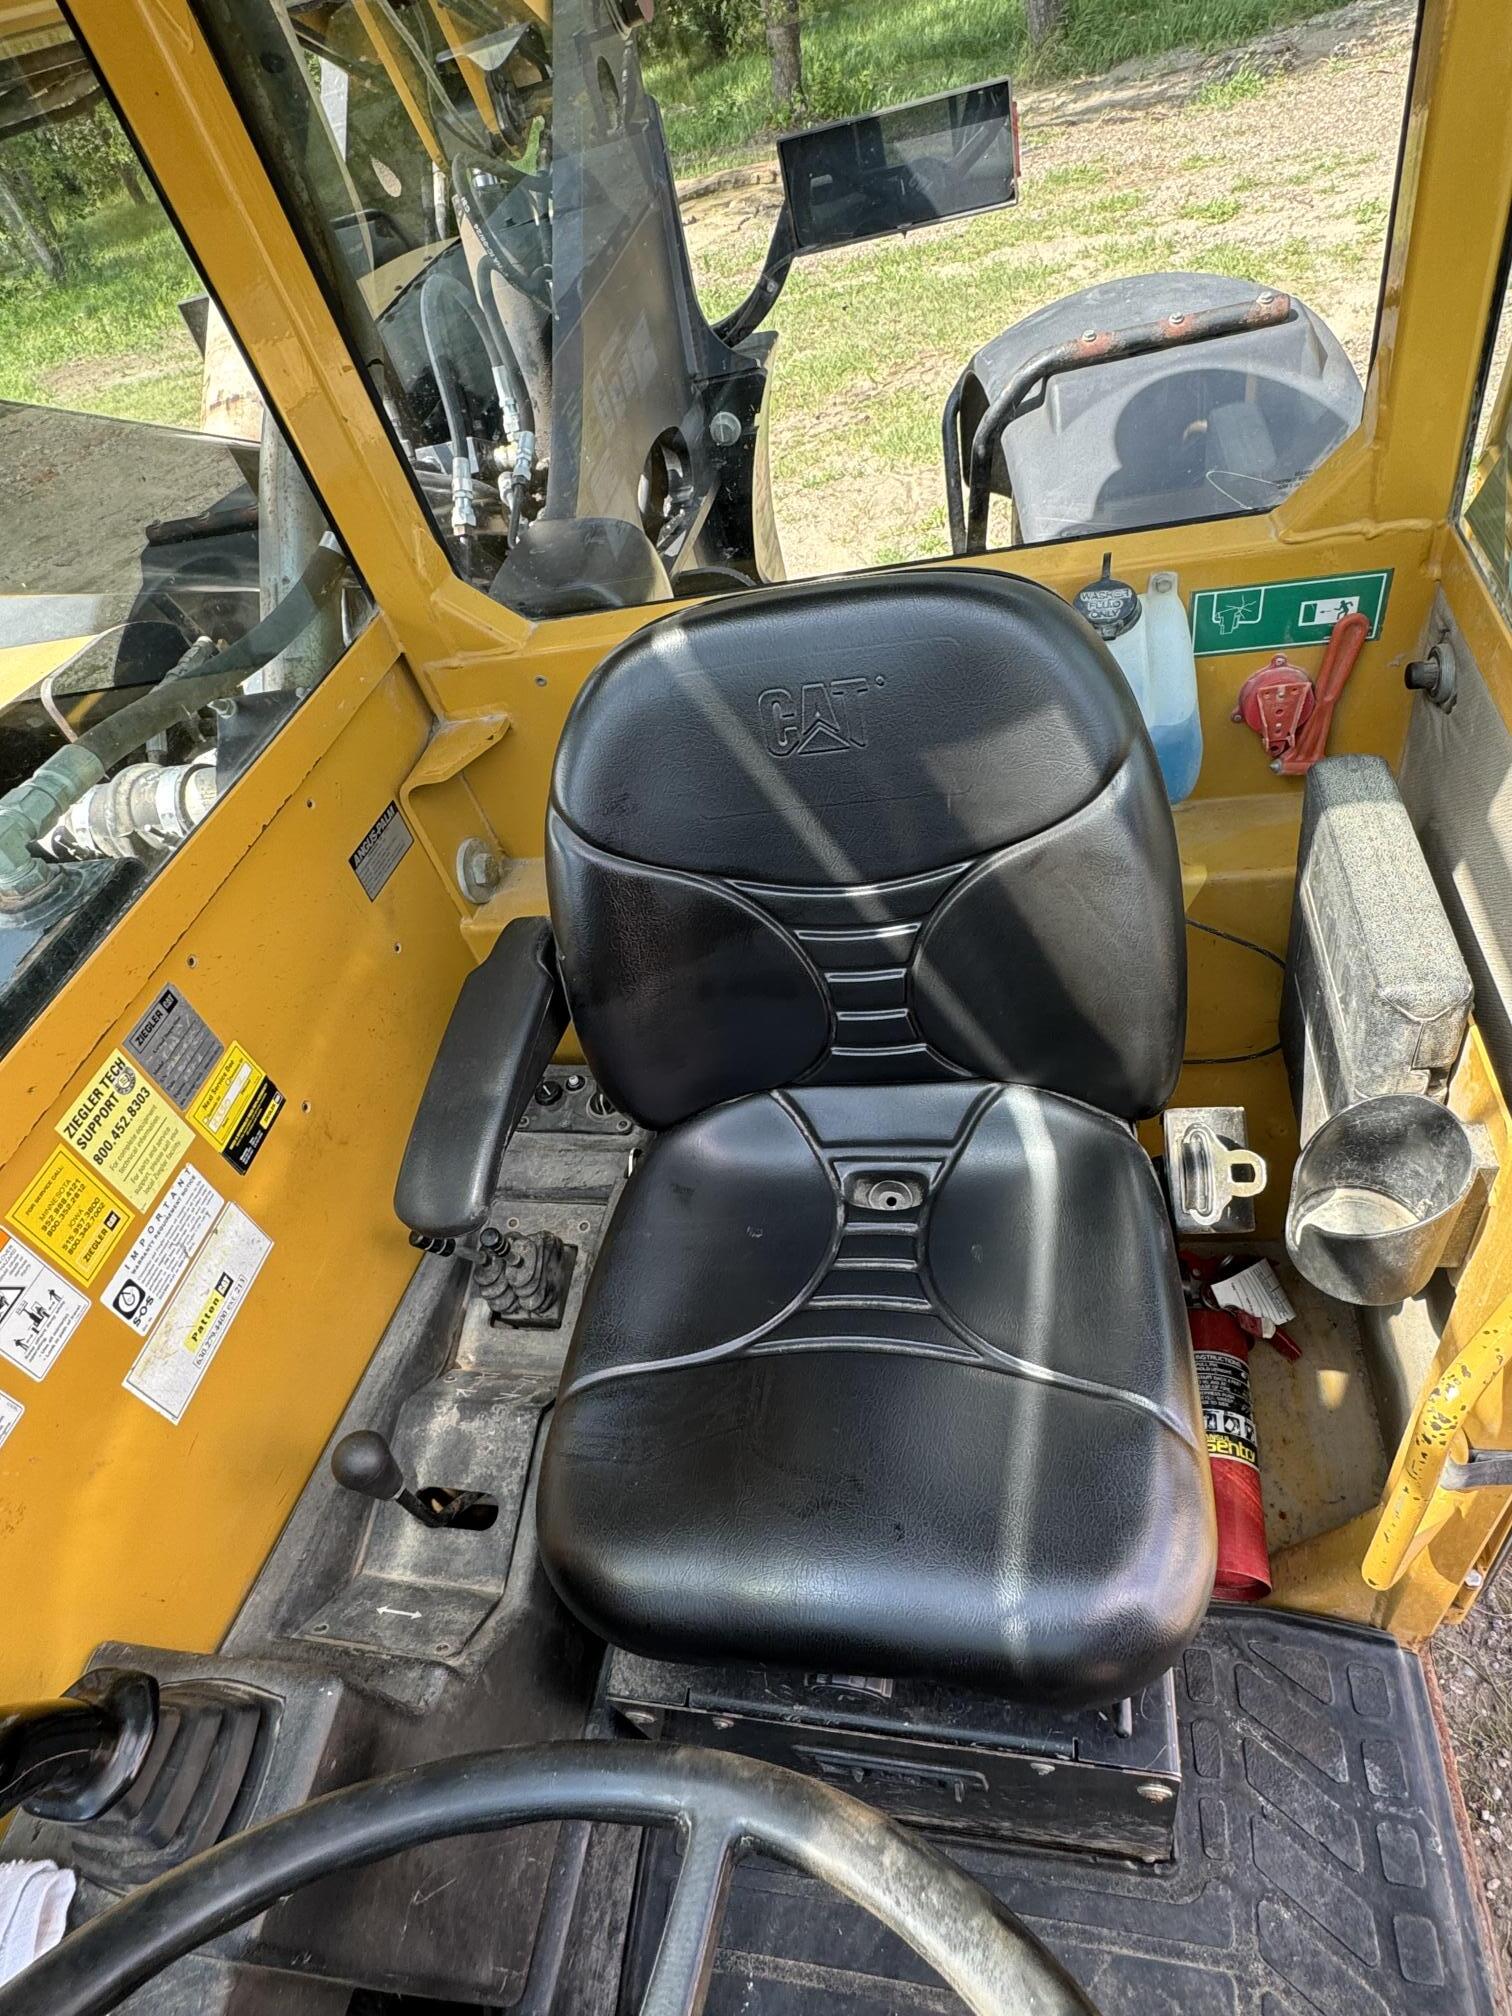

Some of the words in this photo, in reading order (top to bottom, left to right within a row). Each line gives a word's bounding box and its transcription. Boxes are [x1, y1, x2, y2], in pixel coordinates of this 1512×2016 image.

[1089, 609, 1120, 619] ONLY
[758, 678, 868, 758] CAT
[134, 1008, 163, 1046] ZIEGLER
[62, 1086, 105, 1139] ZIEGLER
[98, 1056, 126, 1091] TECH
[201, 1093, 214, 1110] Next
[211, 1071, 227, 1094] Service
[74, 1091, 121, 1151] SUPPORT
[91, 1085, 152, 1166] 800.452.8303
[109, 1159, 119, 1171] For
[116, 1133, 138, 1161] complete
[118, 1146, 139, 1174] technical
[130, 1172, 139, 1183] For
[137, 1156, 151, 1174] parts
[147, 1145, 158, 1158] and
[155, 1126, 171, 1147] service
[149, 1150, 165, 1172] please
[169, 1127, 180, 1142] your
[33, 1179, 53, 1204] SERVICE
[143, 1178, 155, 1194] local
[153, 1158, 169, 1178] Ziegler
[38, 1177, 72, 1222] MINNESOTA
[68, 1207, 84, 1228] IOWA
[82, 1227, 108, 1263] ZIEGLER
[131, 1239, 155, 1275] WARRANTY
[153, 1196, 182, 1239] REQUIREMENT
[180, 1174, 196, 1197] NOTICE
[190, 1295, 220, 1343] Patten
[195, 1309, 229, 1366] 630.279.4400
